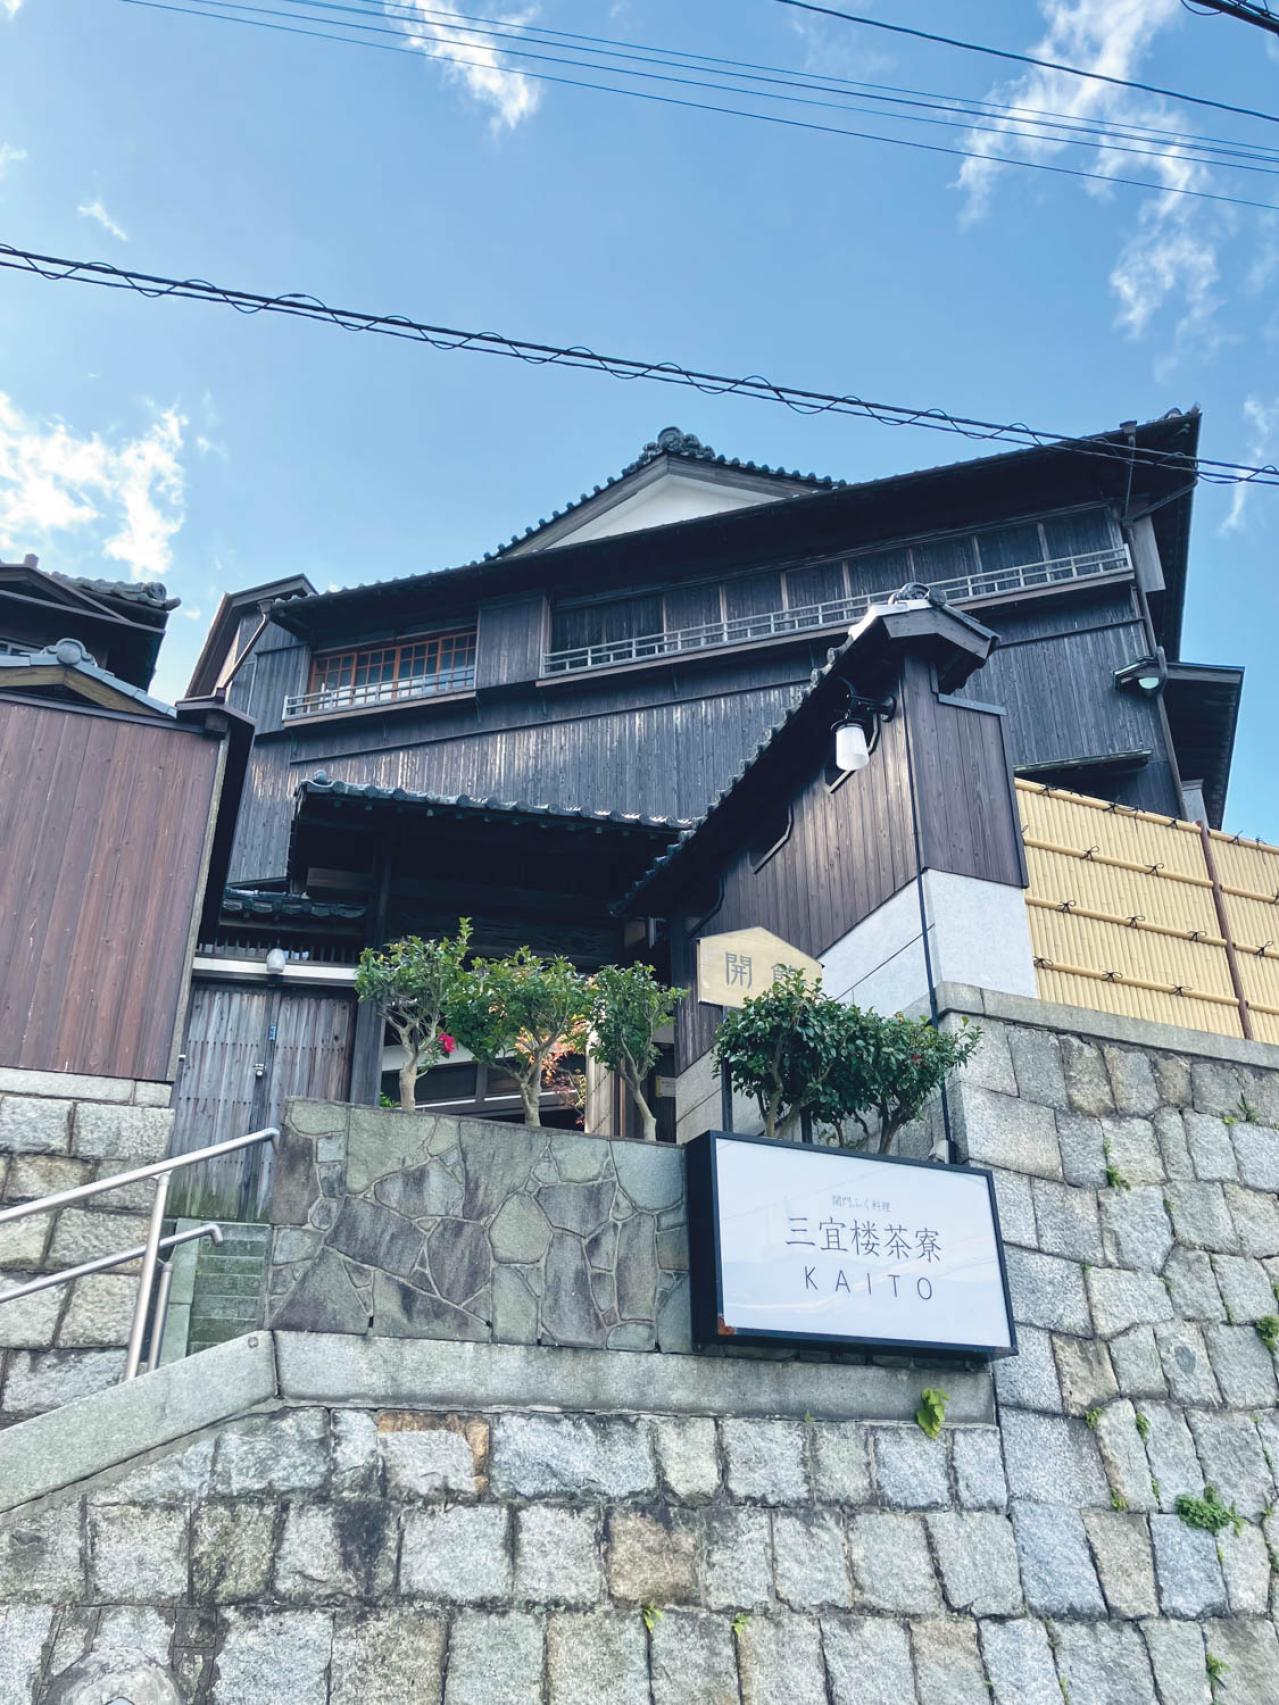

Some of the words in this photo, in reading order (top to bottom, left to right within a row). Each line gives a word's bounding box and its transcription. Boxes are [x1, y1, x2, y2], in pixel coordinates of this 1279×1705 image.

[785, 1215, 943, 1263] 三宜楼茶寮
[804, 1266, 933, 1300] KAITO
